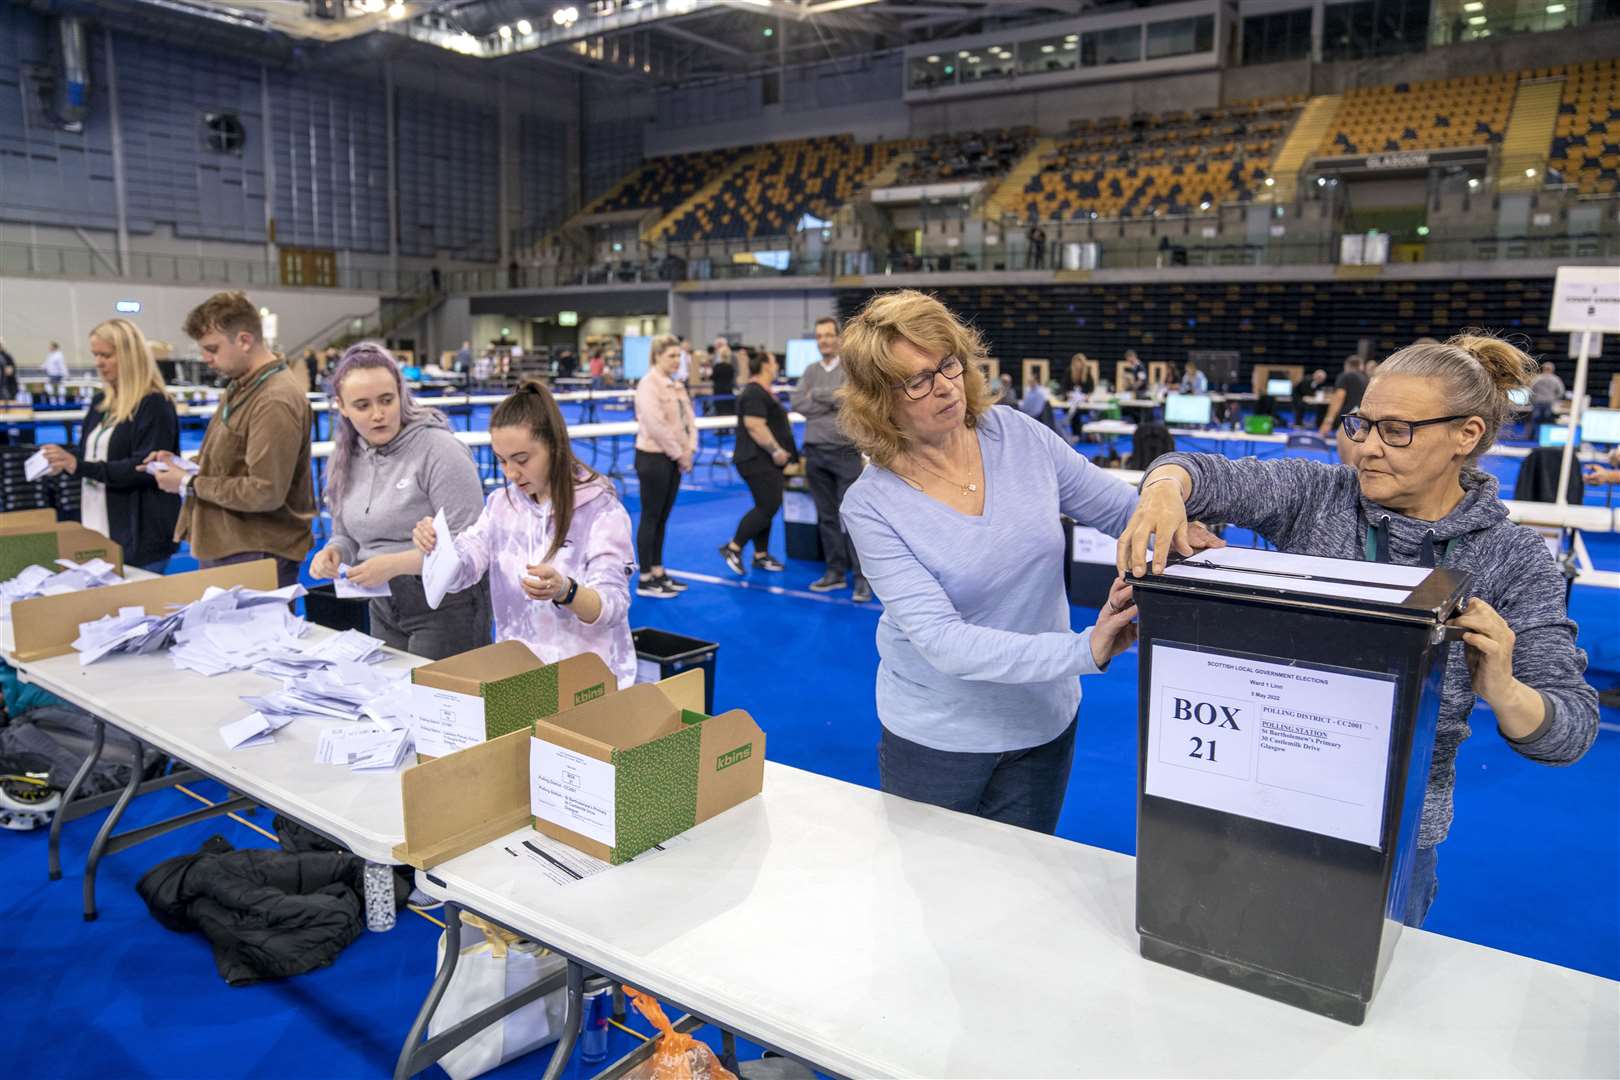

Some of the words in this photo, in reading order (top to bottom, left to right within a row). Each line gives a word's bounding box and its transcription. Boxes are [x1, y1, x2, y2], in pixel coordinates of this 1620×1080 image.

[1207, 661, 1235, 670] SCOTTISH
[1235, 665, 1254, 673] LOCAL
[1254, 668, 1295, 680] GOVERNMENT
[1295, 675, 1329, 685] ELECTIONS
[1249, 679, 1265, 687] Ward
[1172, 696, 1242, 731] BOX
[1263, 706, 1296, 718] POLLING
[1296, 712, 1332, 724] DISTRICT
[1261, 720, 1295, 731] POLLING
[1295, 727, 1328, 739] STATION
[1188, 736, 1217, 762] 21
[1260, 742, 1286, 752] Glasgow
[1302, 743, 1321, 752] Drive
[1315, 739, 1342, 749] Primary
[718, 745, 751, 769] kbins
